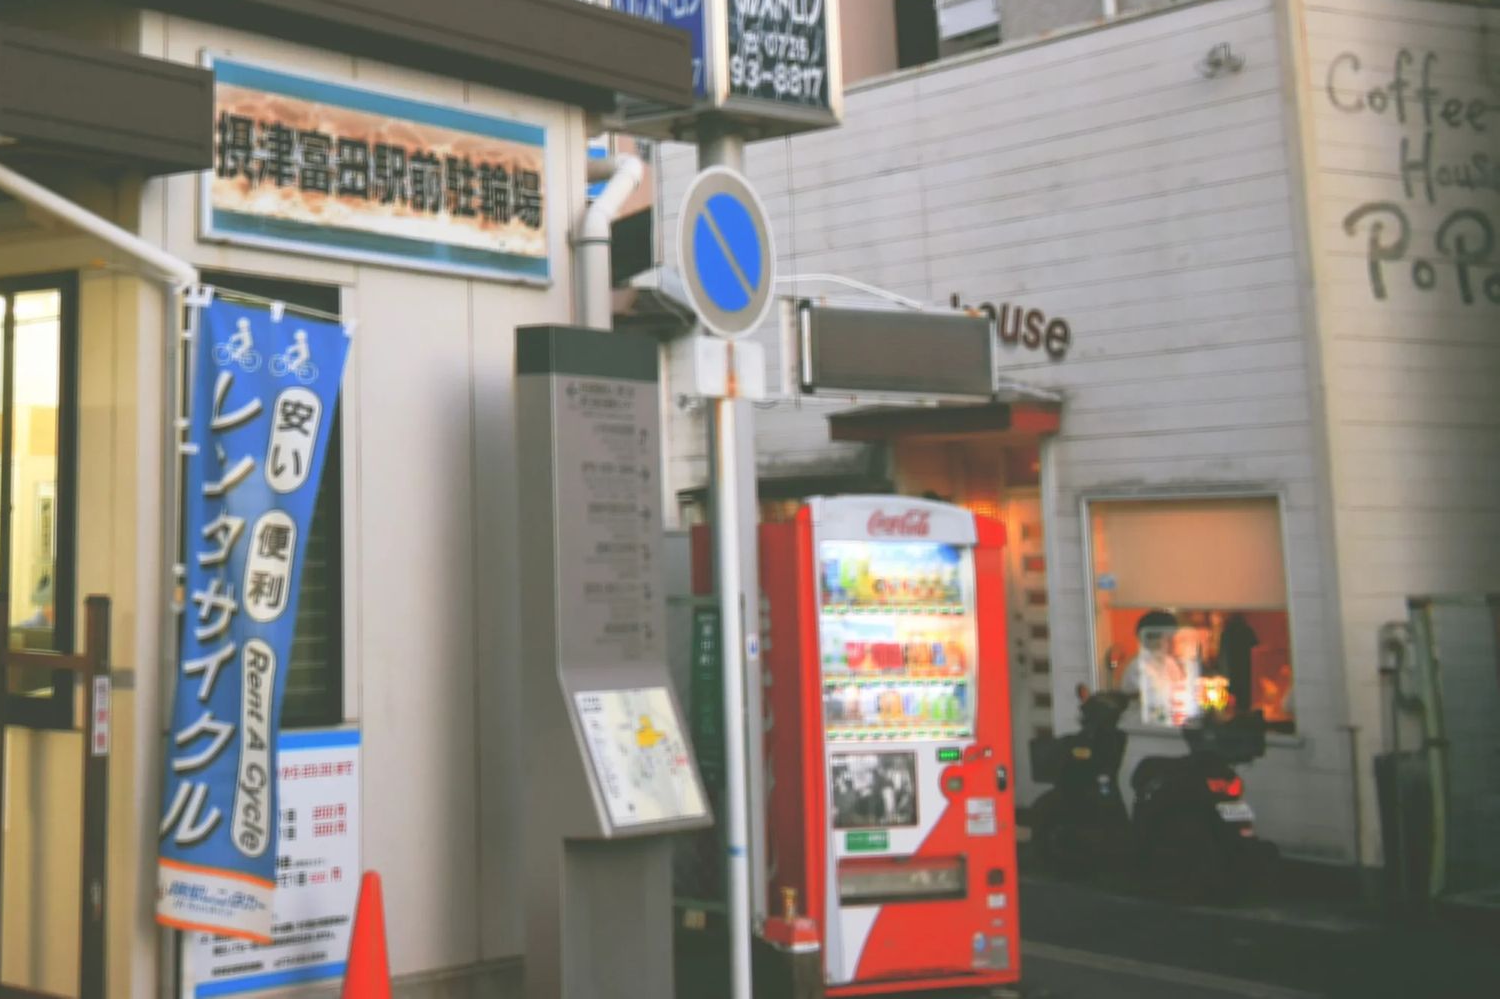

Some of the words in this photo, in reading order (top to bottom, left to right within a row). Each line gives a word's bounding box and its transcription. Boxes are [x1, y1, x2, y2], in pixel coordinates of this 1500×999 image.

[730, 55, 823, 99] 93-8817
[1326, 48, 1498, 133] Coffee
[216, 110, 544, 230] 摂津富田駅前駐輪場
[951, 293, 1071, 361] use
[270, 399, 314, 478] 安い
[246, 522, 291, 610] 便利
[159, 369, 263, 848] レンタサイクル
[245, 646, 271, 723] Rent
[245, 725, 269, 751] A
[238, 761, 268, 852] Cycle
